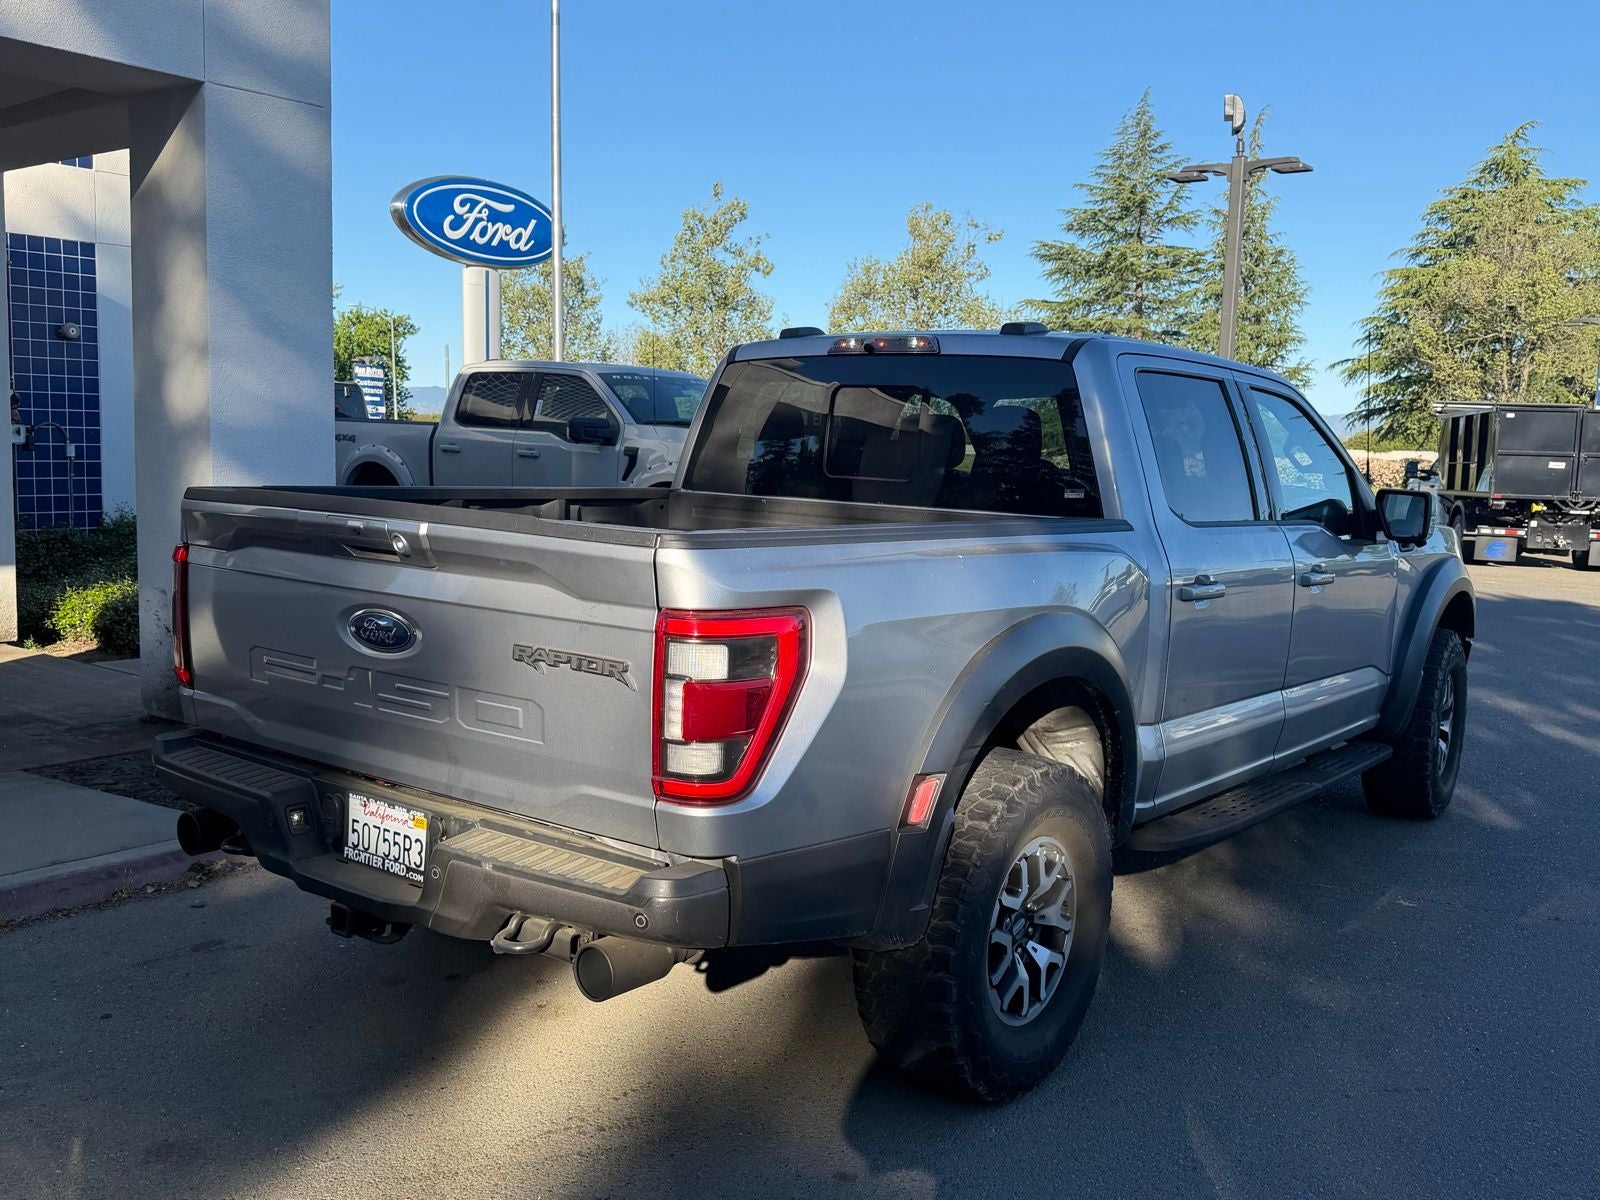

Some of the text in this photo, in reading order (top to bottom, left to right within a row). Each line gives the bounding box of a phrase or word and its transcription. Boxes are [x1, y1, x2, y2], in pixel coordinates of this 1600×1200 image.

[443, 193, 537, 251] Ford
[362, 387, 383, 395] ntrance
[360, 617, 397, 644] Ford
[512, 643, 637, 692] RAPTOR
[249, 645, 545, 744] F-150
[361, 802, 409, 825] California
[344, 846, 424, 882] FRONTIER FORD.COM
[352, 818, 424, 869] 50755R3
